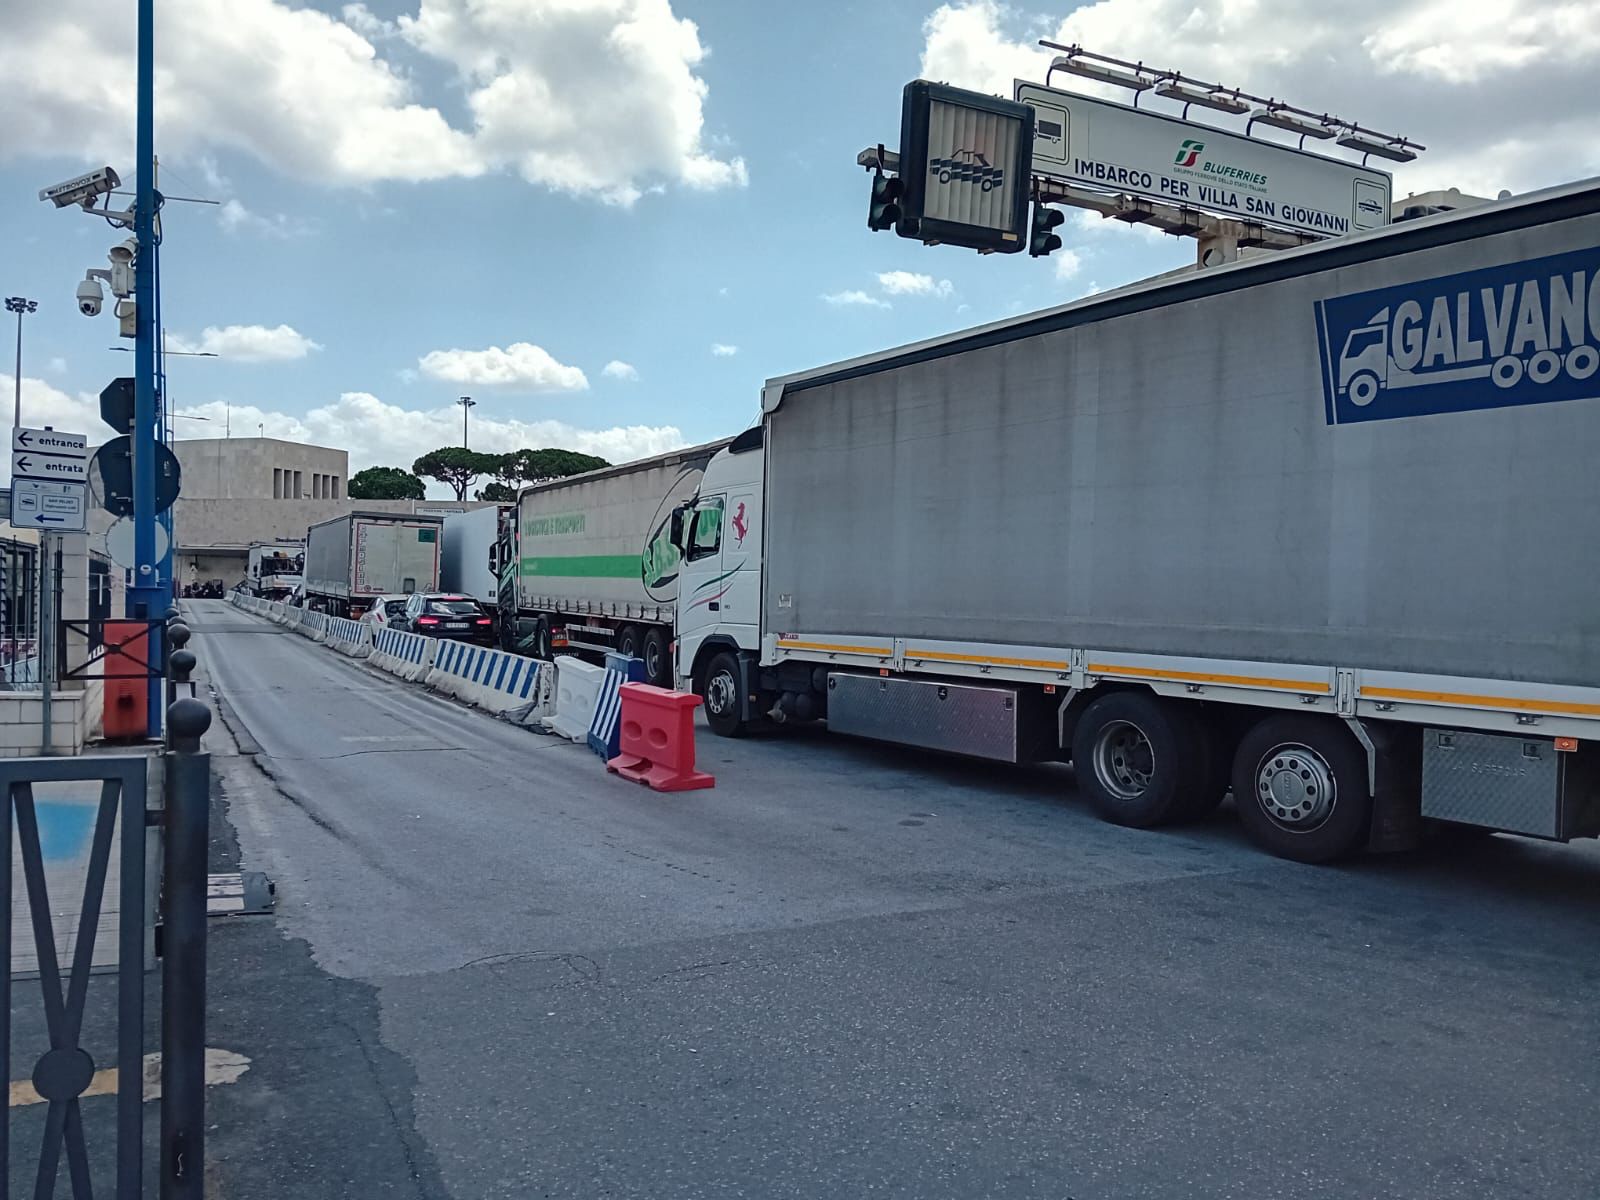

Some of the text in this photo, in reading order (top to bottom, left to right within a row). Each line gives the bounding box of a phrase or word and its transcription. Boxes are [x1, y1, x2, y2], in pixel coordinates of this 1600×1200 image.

[1203, 161, 1268, 185] BLUFERRIES
[1074, 158, 1349, 233] IMBARCO PER VILLA SAN GIOVANNI
[38, 437, 84, 449] entrance
[45, 463, 83, 473] entrata
